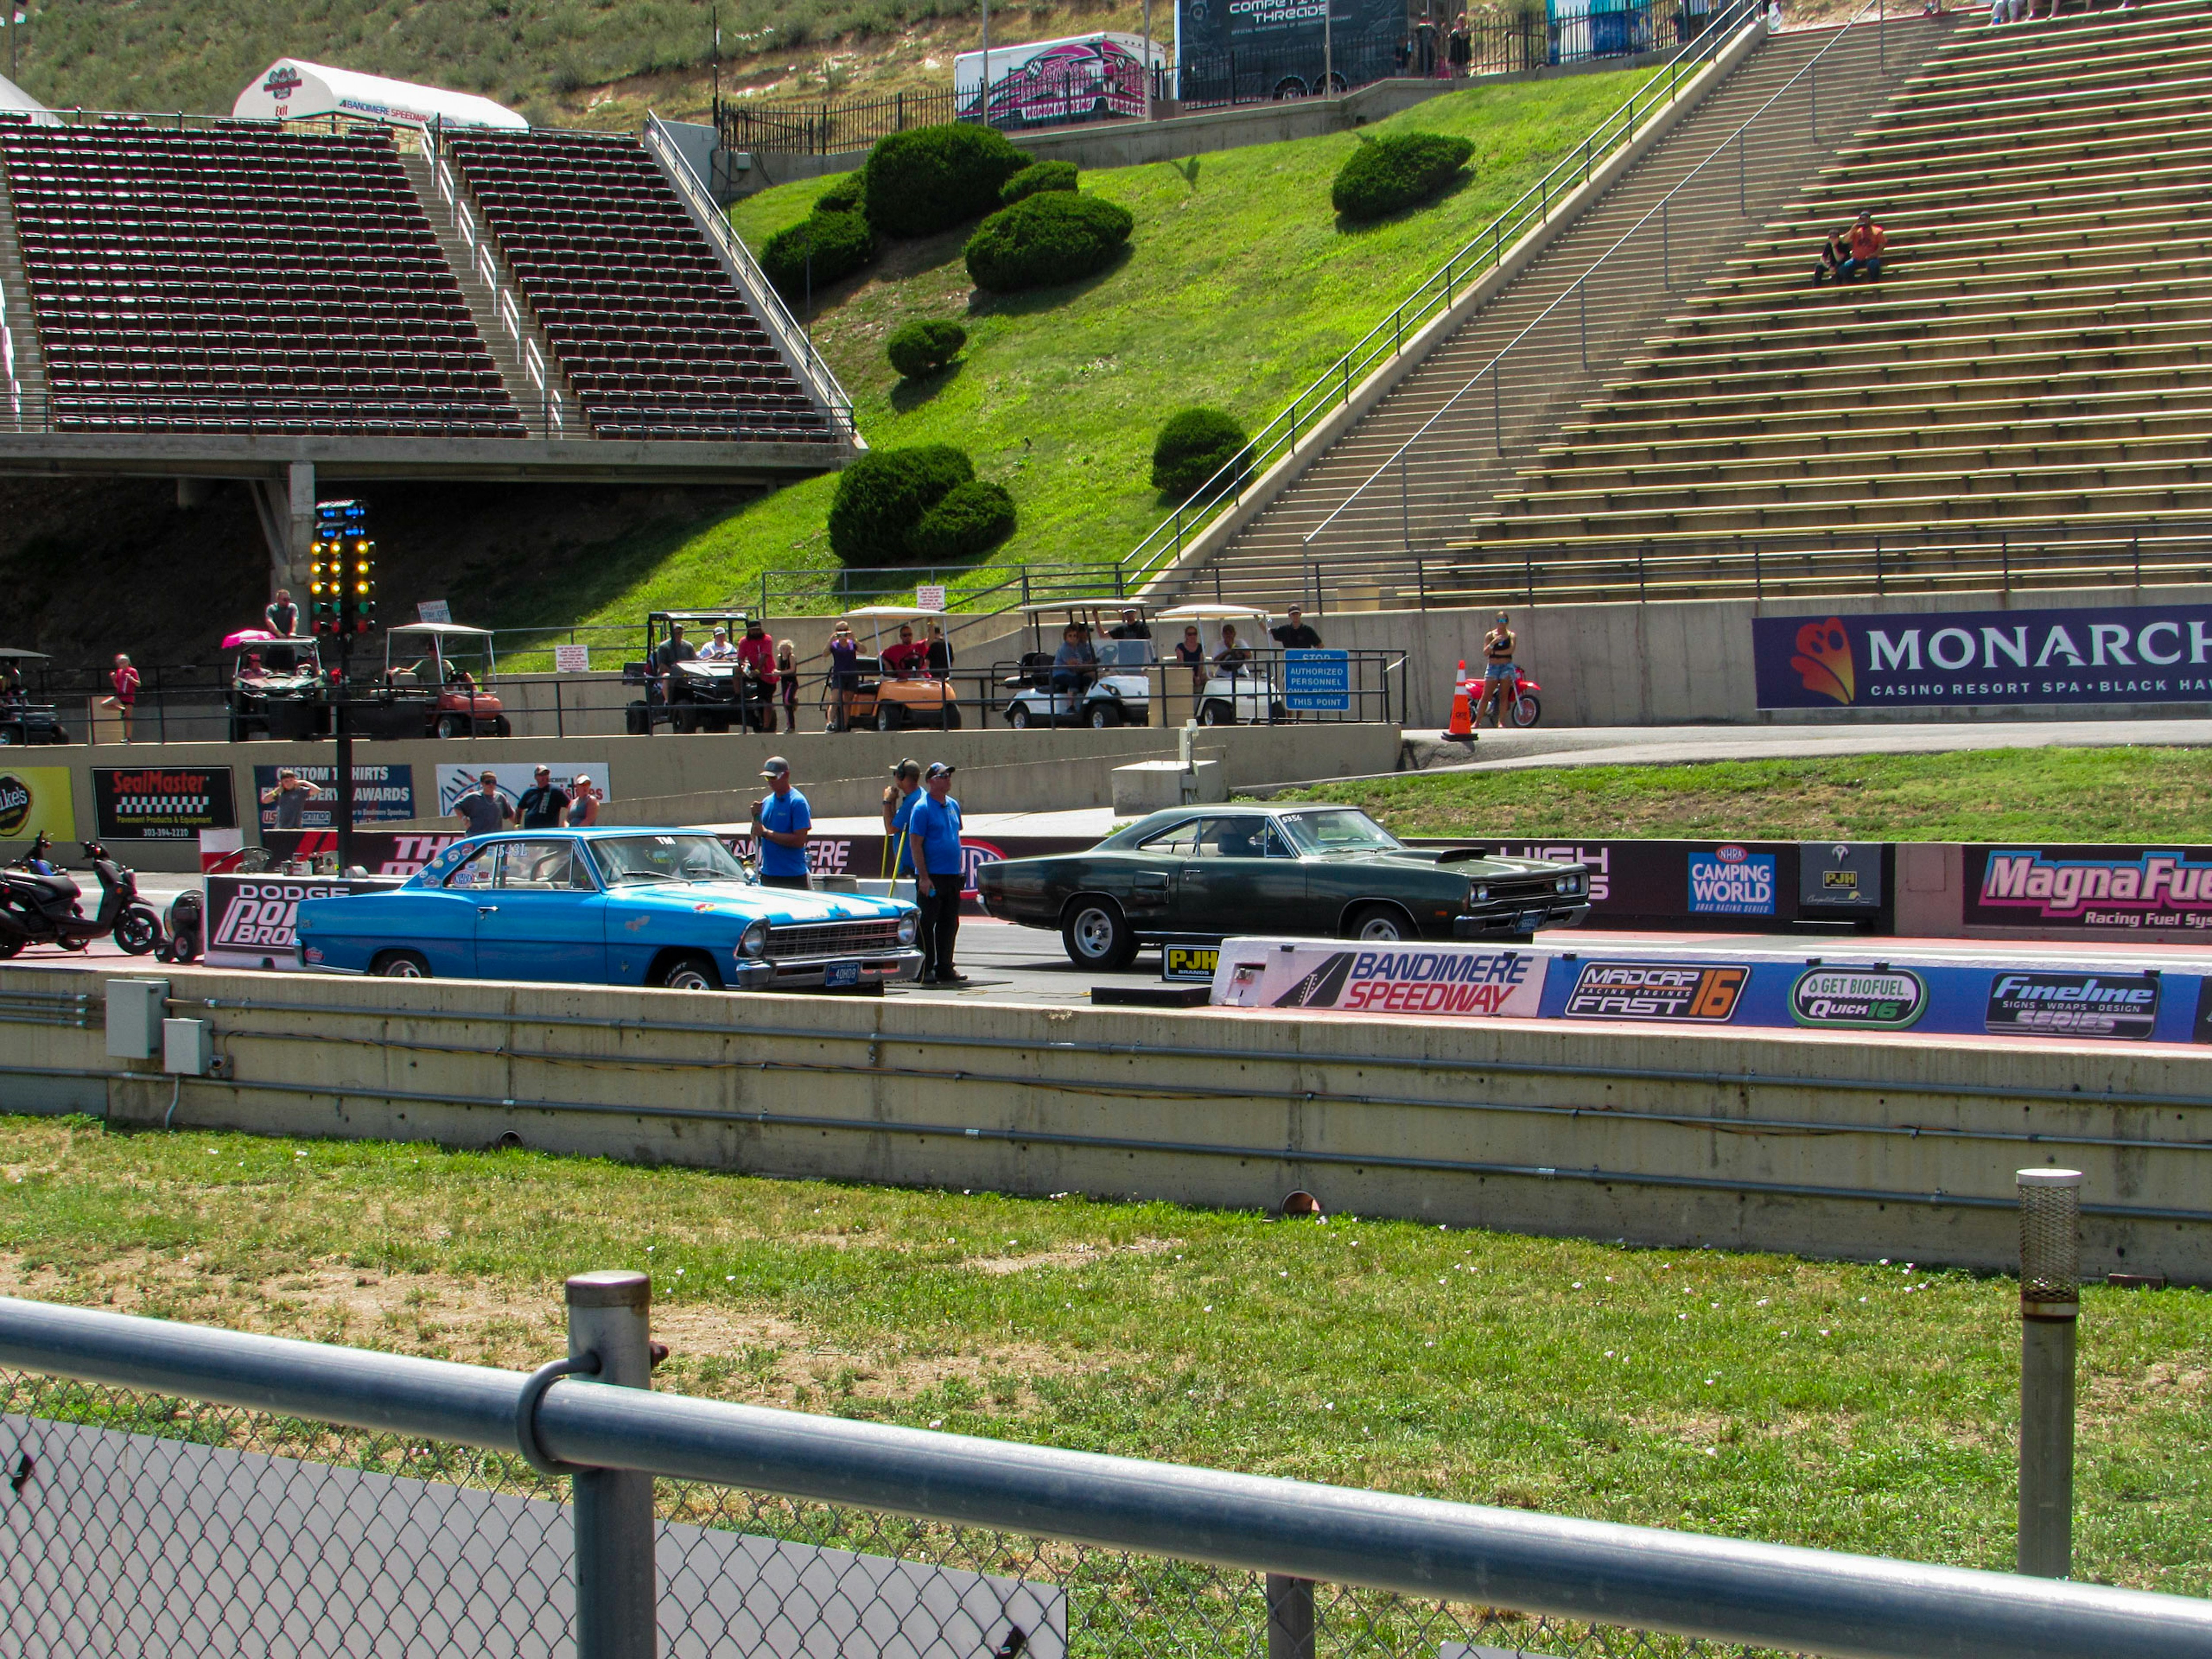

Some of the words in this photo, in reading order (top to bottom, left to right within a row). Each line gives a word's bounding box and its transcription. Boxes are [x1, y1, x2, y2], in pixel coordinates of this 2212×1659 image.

[276, 105, 288, 117] Exit
[347, 100, 390, 115] BANDIMERE
[391, 109, 430, 122] SPEEDWAY
[1302, 654, 1330, 664] STOP
[1871, 684, 1943, 696] CASINO
[1952, 683, 2030, 694] RESORT
[2042, 682, 2080, 693] SPA
[2100, 680, 2167, 692] BLACK
[113, 771, 206, 793] SealMaster
[353, 787, 410, 802] AWARDS
[654, 836, 676, 845] TM
[1720, 849, 1743, 860] NHRA
[1692, 864, 1770, 883] CAMPING
[1825, 873, 1855, 884] PJH
[238, 884, 350, 900] DODGE
[1693, 881, 1770, 903] WORLD
[2085, 911, 2140, 926] Racing
[2145, 912, 2181, 925] Fuel
[1169, 949, 1218, 970] PJH
[1351, 952, 1534, 984] BANDIMERE
[1583, 968, 1700, 986] MADCAP
[1688, 970, 1743, 1017] 16
[1820, 978, 1847, 994] GET
[1849, 979, 1905, 996] BIOFUEL
[1344, 981, 1516, 1013] SPEEDWAY
[1571, 995, 1689, 1014] FAST
[2002, 1000, 2035, 1009] SIGNS
[2047, 1002, 2087, 1011] WRAPS
[2098, 1004, 2140, 1013] DESIGN
[2016, 1010, 2115, 1034] SERIES
